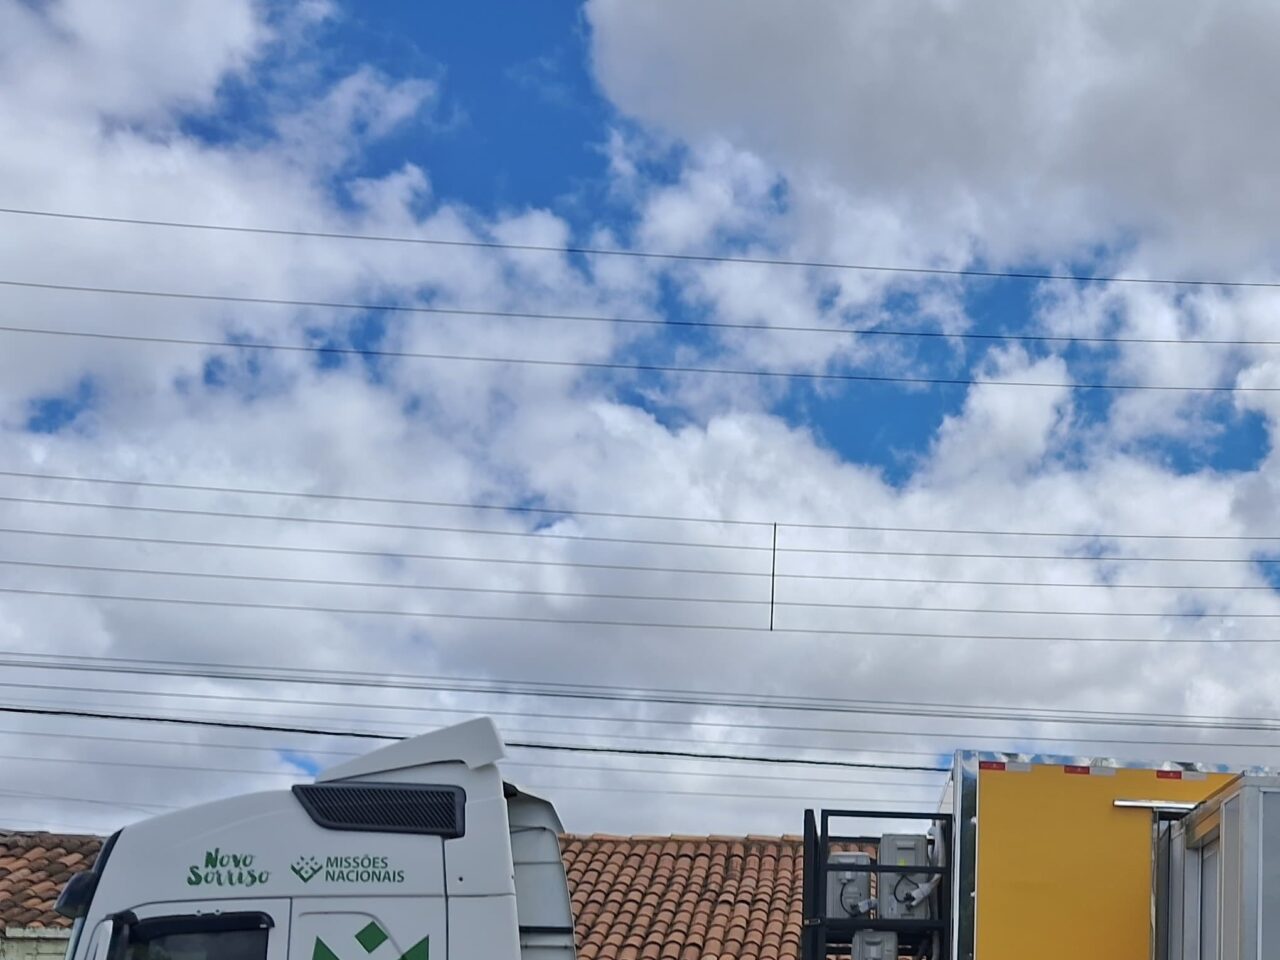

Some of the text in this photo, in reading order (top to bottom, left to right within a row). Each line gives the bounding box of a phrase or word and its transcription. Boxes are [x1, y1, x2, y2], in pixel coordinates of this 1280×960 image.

[204, 848, 254, 868] Novo
[325, 854, 389, 869] MISSÕES
[187, 866, 270, 887] Sorriso
[325, 870, 405, 883] NACIONAIS
